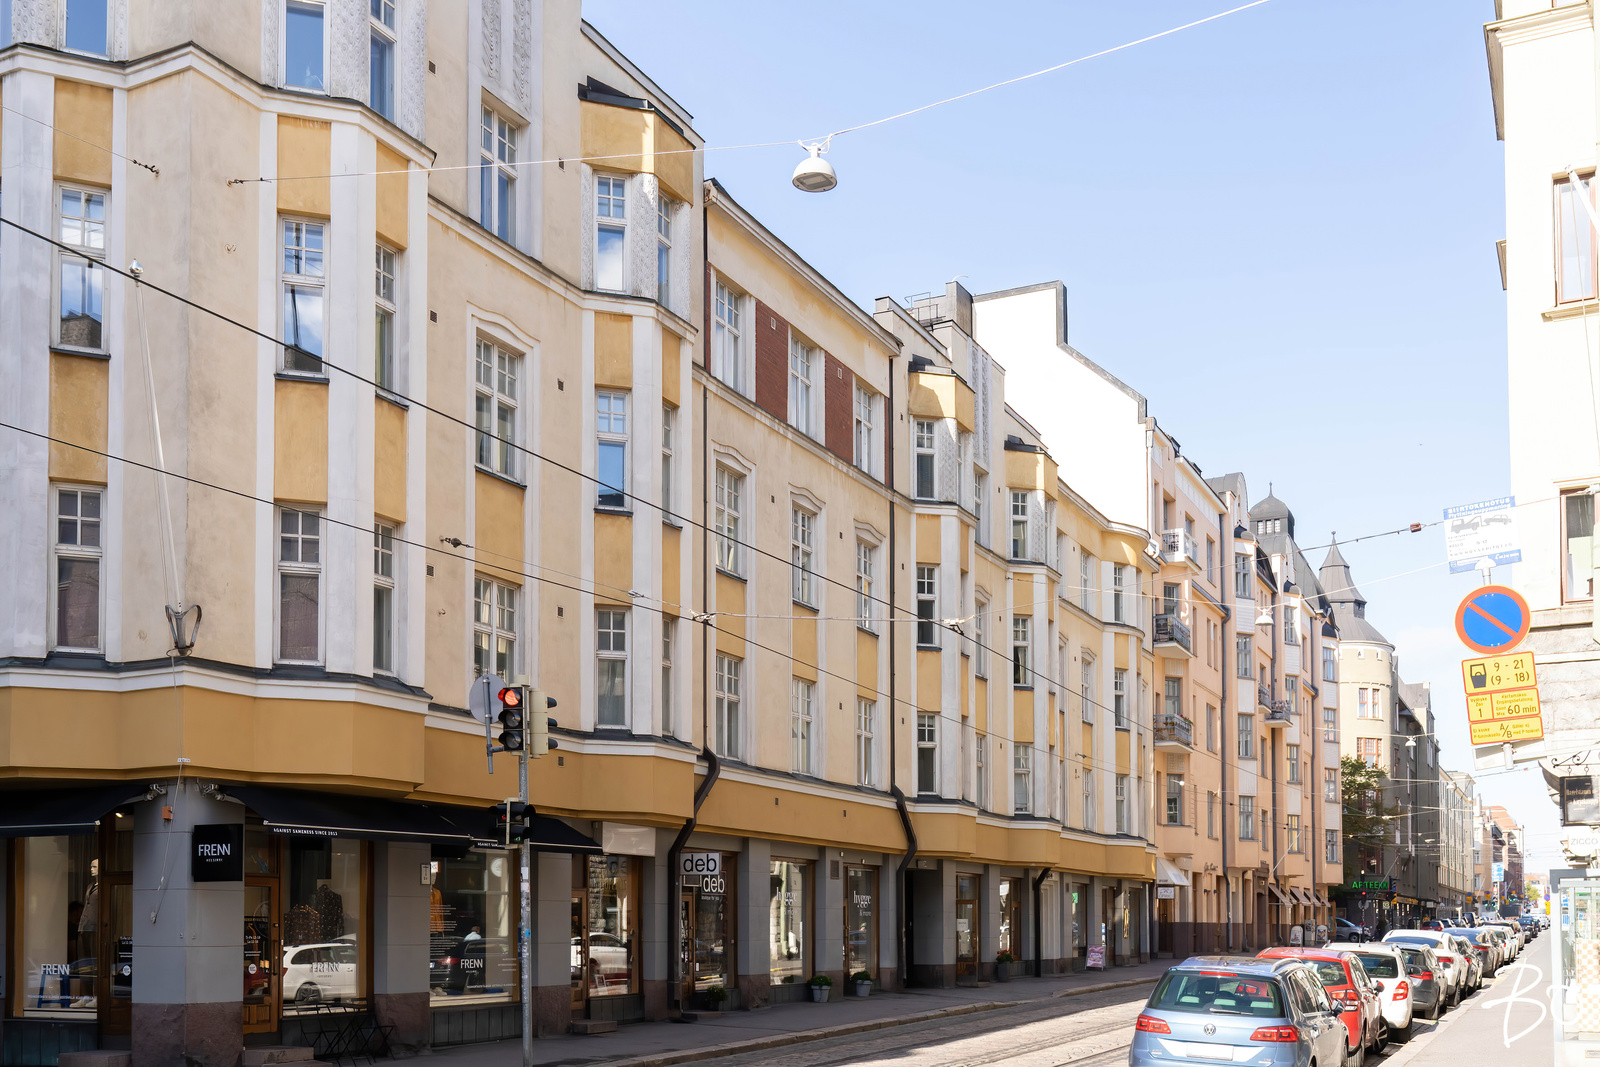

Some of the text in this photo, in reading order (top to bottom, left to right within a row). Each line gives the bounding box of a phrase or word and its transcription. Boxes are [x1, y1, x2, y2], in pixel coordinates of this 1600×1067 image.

[1493, 662, 1500, 672] 9
[1513, 659, 1524, 669] 21
[1490, 675, 1502, 685] (9
[1515, 671, 1530, 682] 18)
[1478, 708, 1482, 718] 1
[1507, 704, 1537, 715] 60 min
[1570, 837, 1598, 846] ZICCO
[198, 843, 231, 857] FRENN
[683, 854, 717, 873] deb
[702, 876, 725, 893] deb
[853, 890, 872, 908] hygge
[41, 963, 70, 975] FRENN
[460, 958, 483, 969] FRENN
